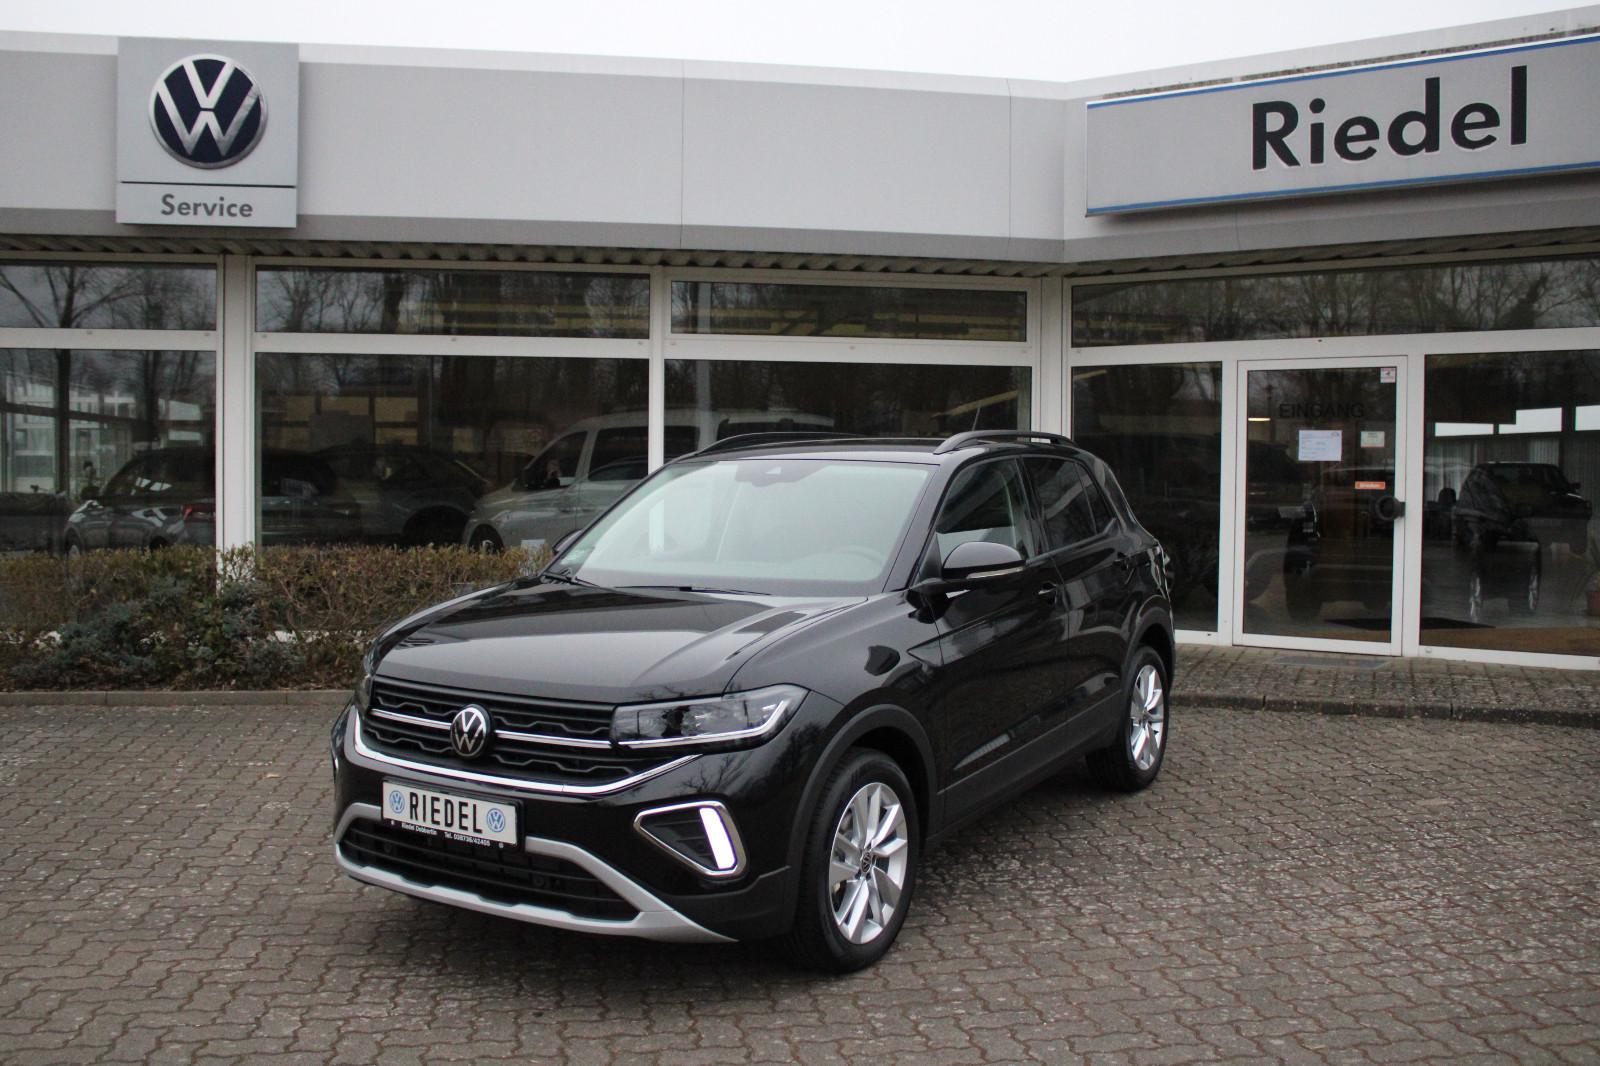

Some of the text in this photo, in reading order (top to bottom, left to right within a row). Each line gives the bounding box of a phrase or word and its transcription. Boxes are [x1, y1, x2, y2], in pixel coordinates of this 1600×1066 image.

[149, 54, 268, 170] VW
[1253, 65, 1527, 170] Riedel
[161, 193, 253, 217] Service
[1280, 402, 1364, 418] EINGANG
[451, 707, 486, 756] VW
[409, 792, 483, 834] RIEDEL
